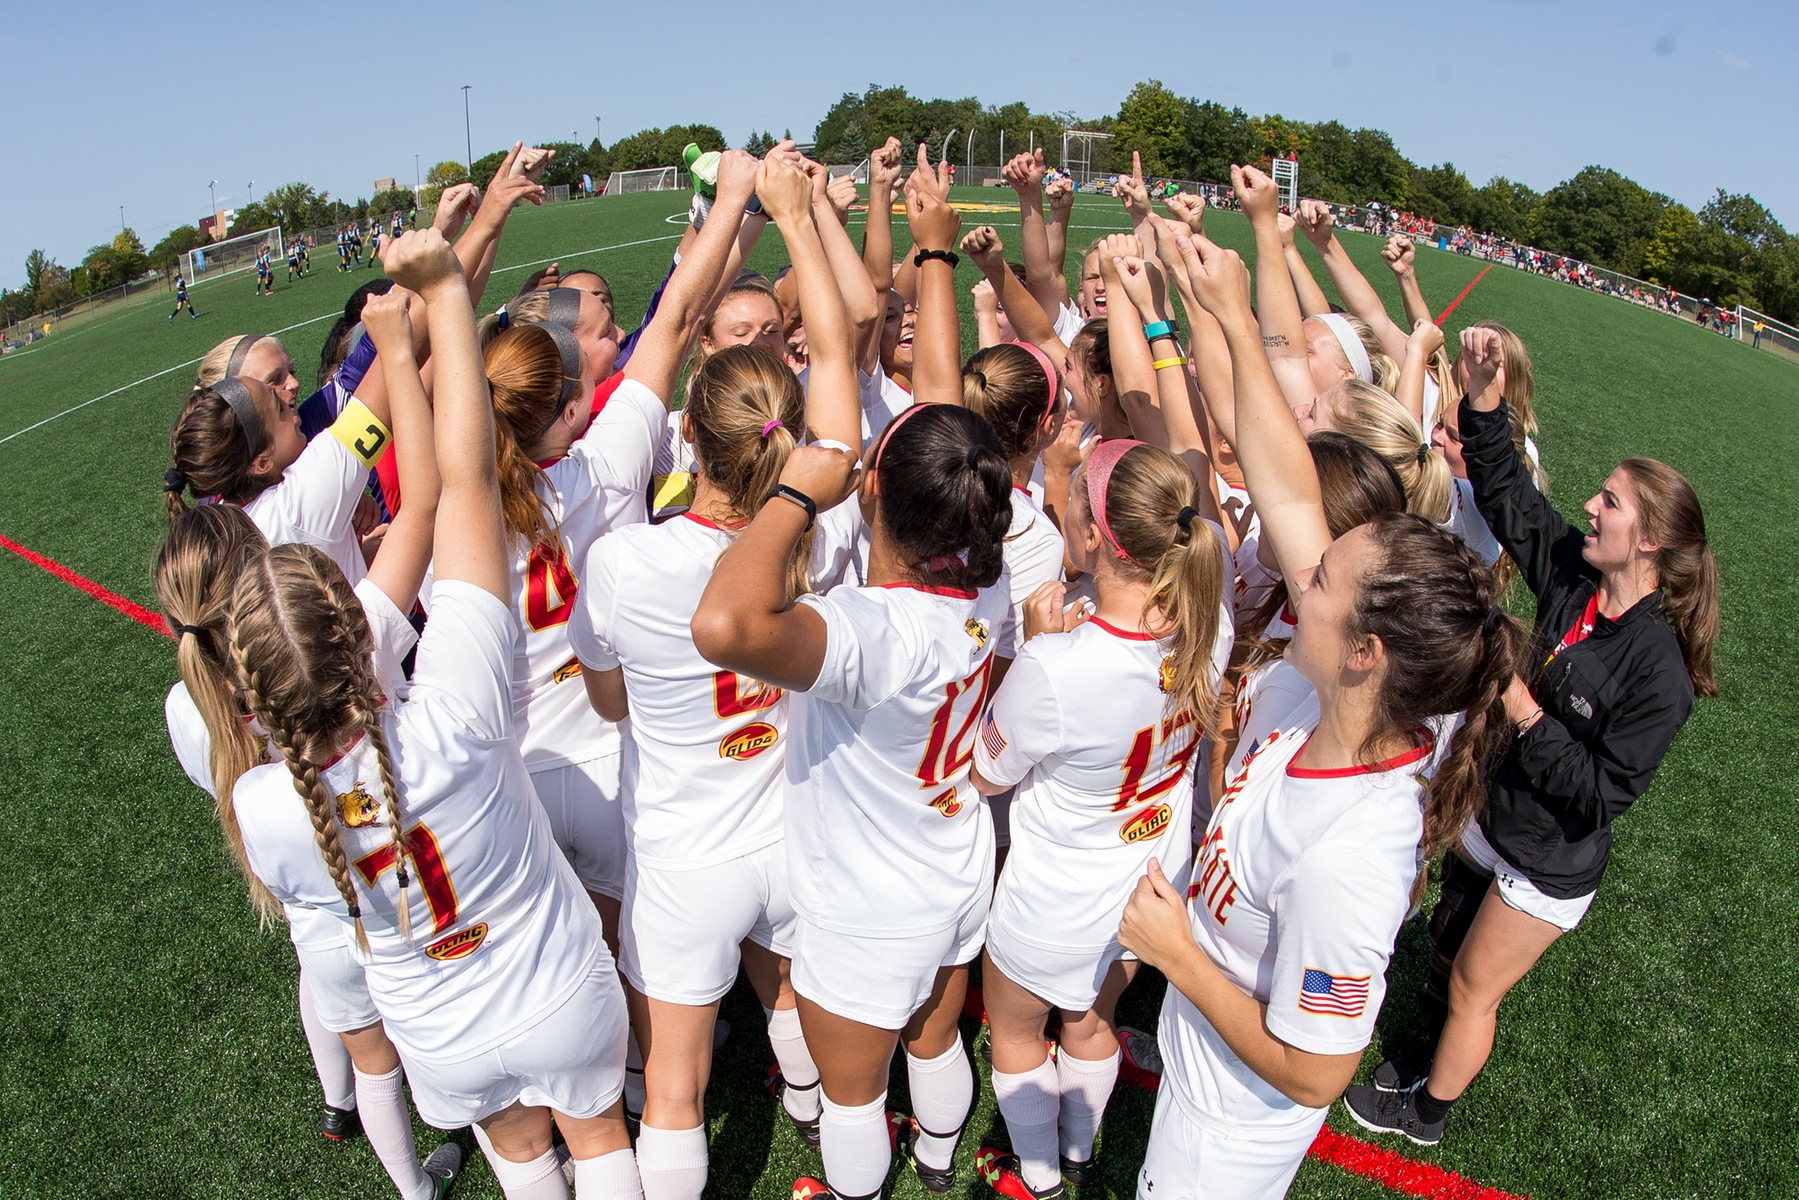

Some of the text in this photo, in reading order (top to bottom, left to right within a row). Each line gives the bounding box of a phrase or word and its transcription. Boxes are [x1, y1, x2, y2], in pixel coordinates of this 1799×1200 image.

[354, 424, 386, 460] C
[915, 649, 995, 790] 12
[1110, 707, 1205, 812] 13
[1128, 808, 1169, 841] GLIAC
[351, 820, 460, 938] 7
